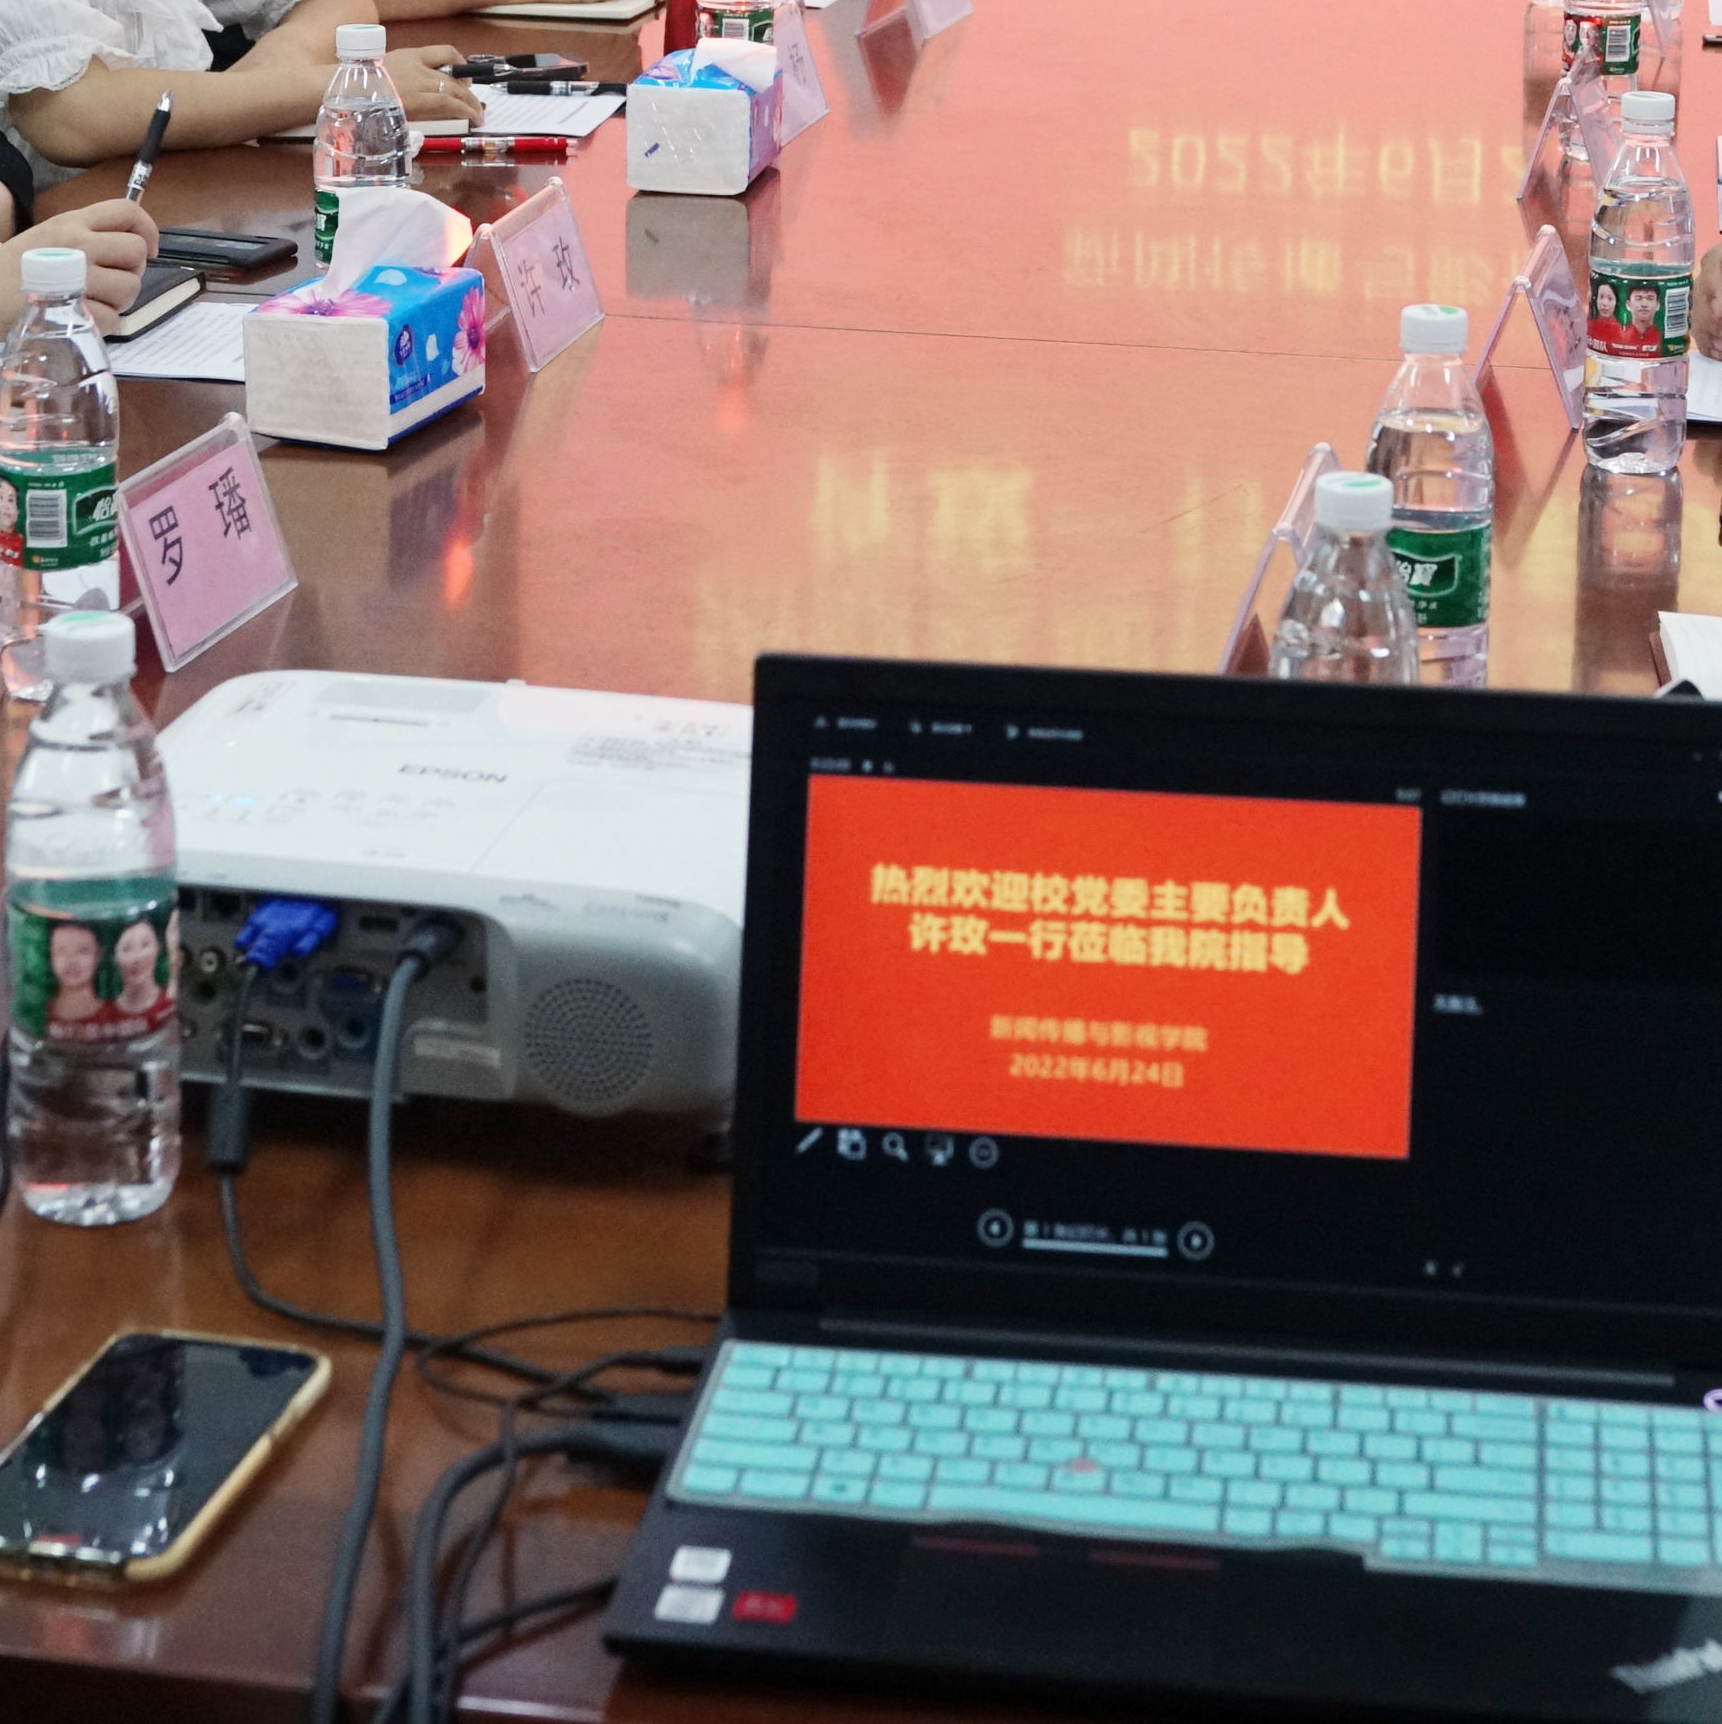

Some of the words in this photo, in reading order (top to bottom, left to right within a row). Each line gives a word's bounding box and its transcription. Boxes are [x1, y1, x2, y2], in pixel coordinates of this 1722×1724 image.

[872, 862, 1350, 931] 热烈欢迎校党委主要负责人
[909, 913, 1308, 975] 许玫一行莅临我院指导
